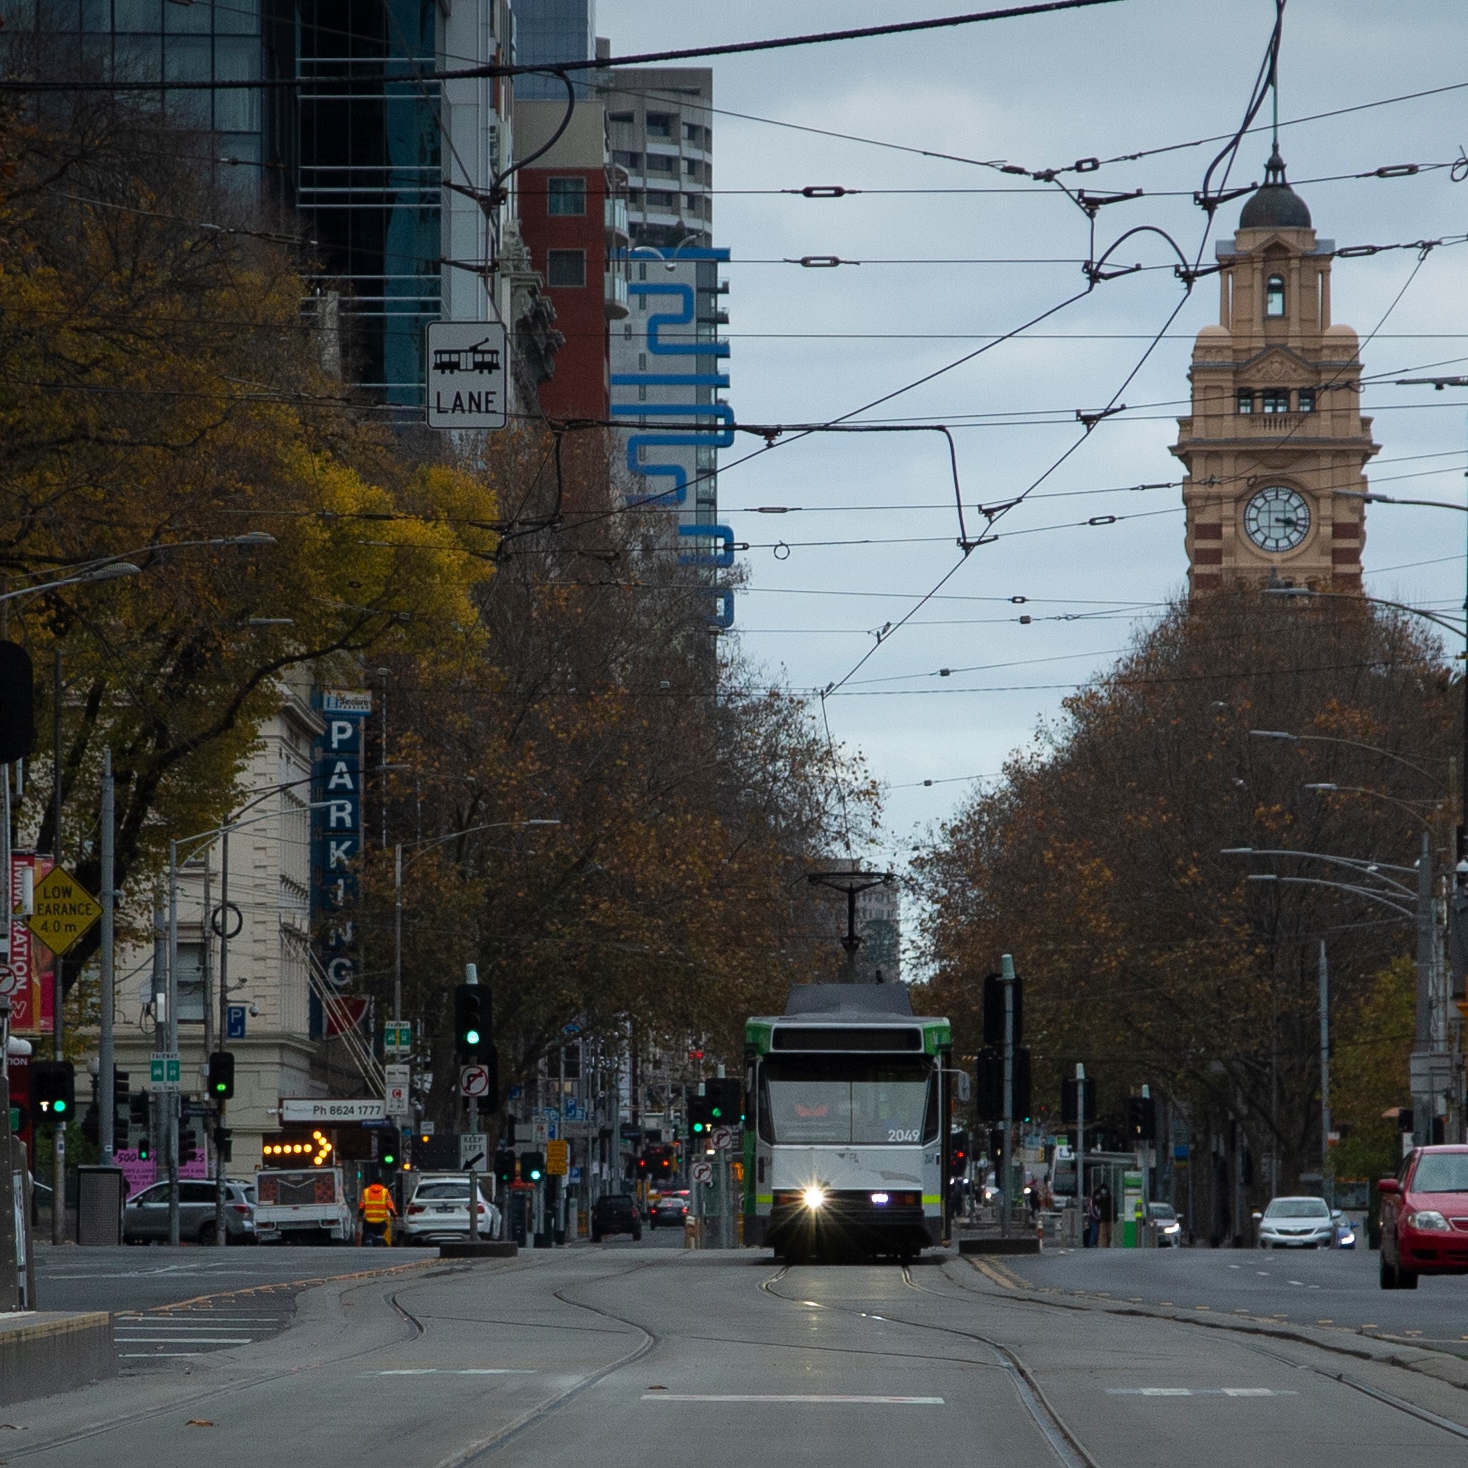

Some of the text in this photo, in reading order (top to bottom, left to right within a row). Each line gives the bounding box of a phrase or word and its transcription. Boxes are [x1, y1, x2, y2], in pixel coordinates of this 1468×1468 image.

[437, 391, 497, 414] LANE
[327, 720, 354, 986] PARKING
[43, 886, 72, 899] LOW
[37, 903, 93, 916] EARANCE
[13, 860, 29, 989] IMMRATION
[40, 920, 77, 932] 4.0 m
[231, 1009, 242, 1023] P
[313, 1105, 327, 1115] Ph
[329, 1105, 355, 1115] 8624
[358, 1105, 382, 1115] 1777
[888, 1130, 920, 1142] 2049
